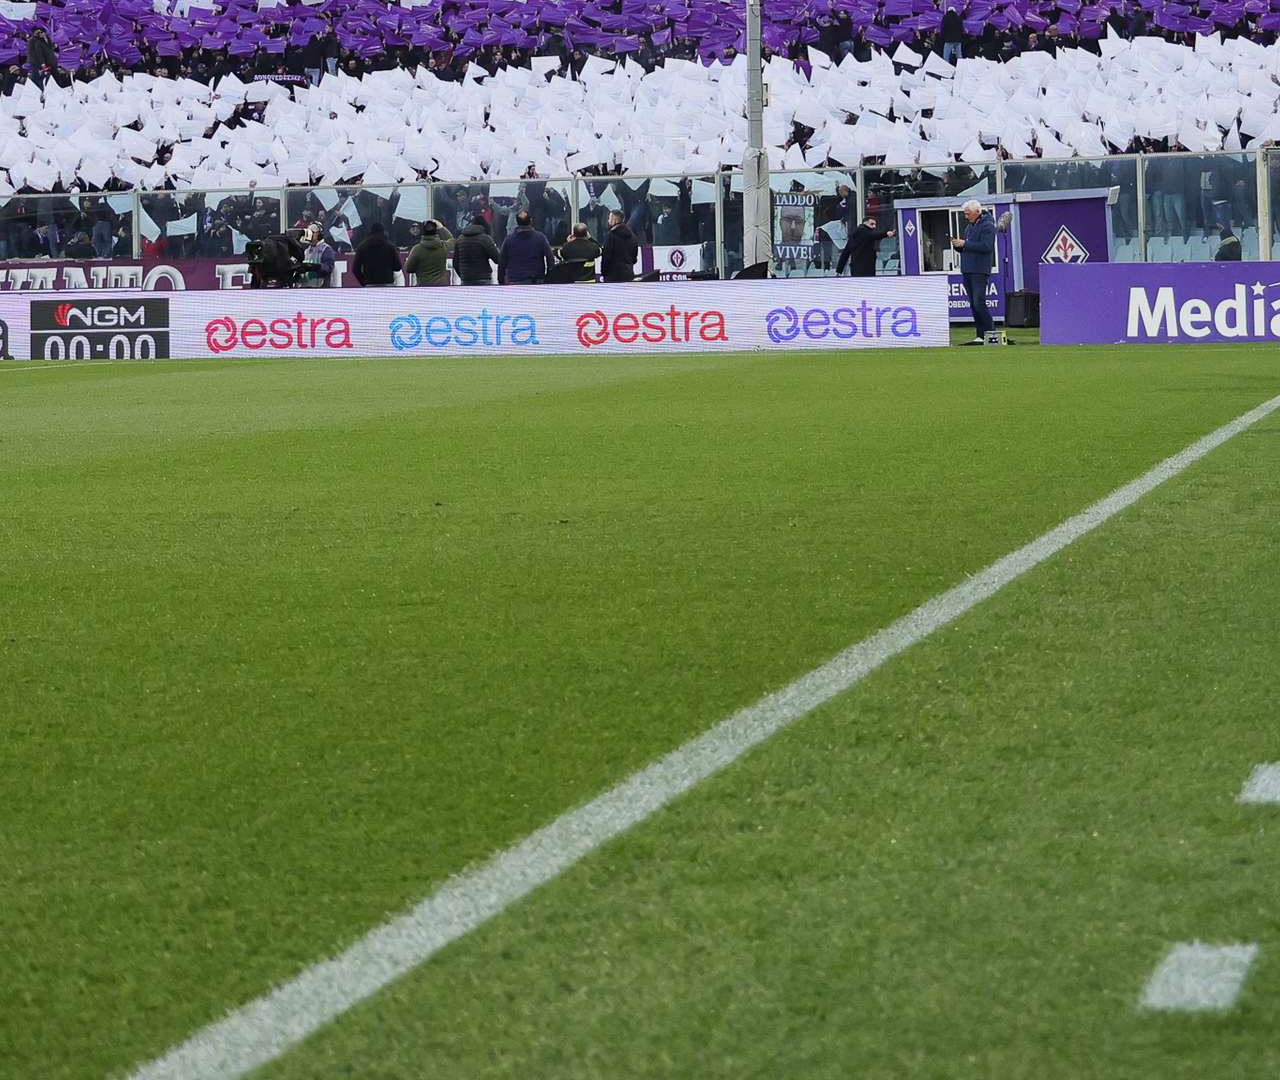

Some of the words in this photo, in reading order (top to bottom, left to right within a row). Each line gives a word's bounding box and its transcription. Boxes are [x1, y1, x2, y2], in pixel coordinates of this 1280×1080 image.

[775, 245, 812, 261] VIVE!
[65, 304, 146, 327] NGM
[240, 311, 354, 350] estra
[425, 307, 541, 347] estra
[612, 304, 729, 343] estra
[802, 300, 921, 339] estra
